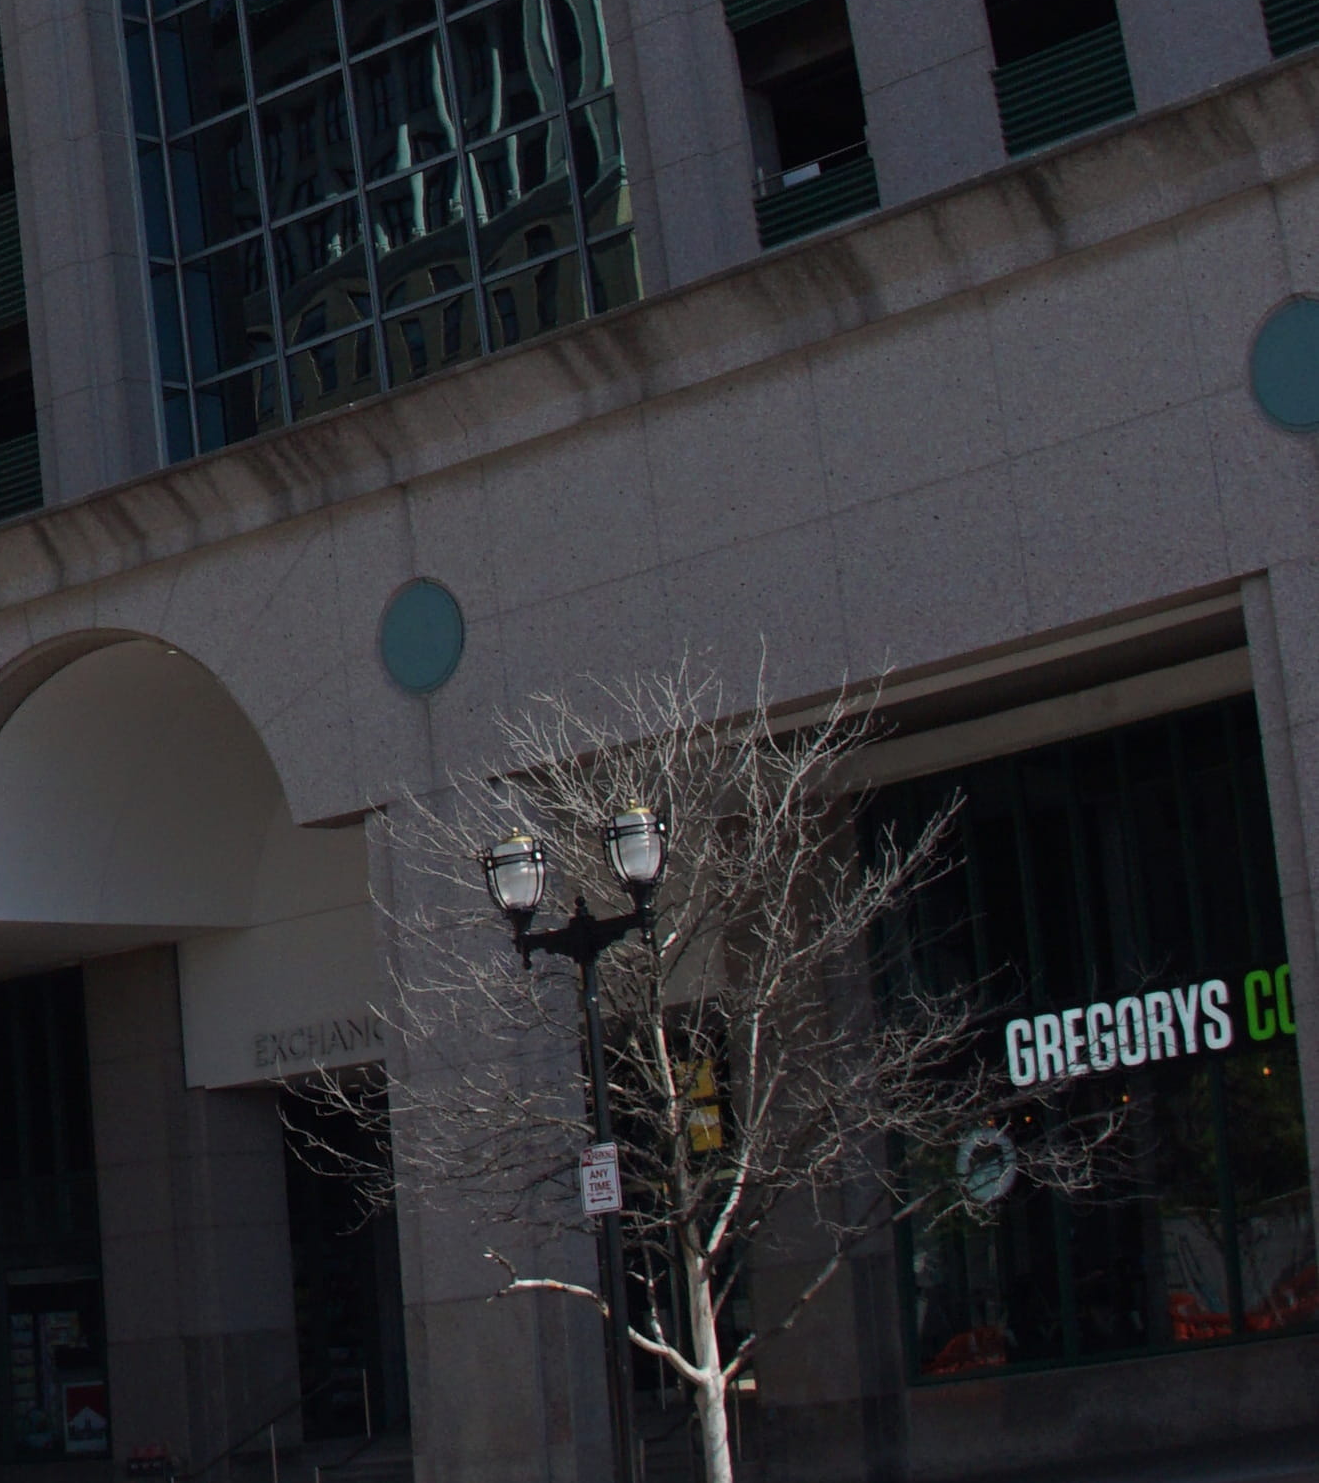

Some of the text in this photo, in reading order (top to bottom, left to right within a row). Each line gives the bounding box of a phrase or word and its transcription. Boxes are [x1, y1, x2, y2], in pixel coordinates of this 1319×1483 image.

[1005, 979, 1234, 1088] GREGORYS
[589, 1168, 609, 1179] ANY
[588, 1180, 612, 1191] TIME
